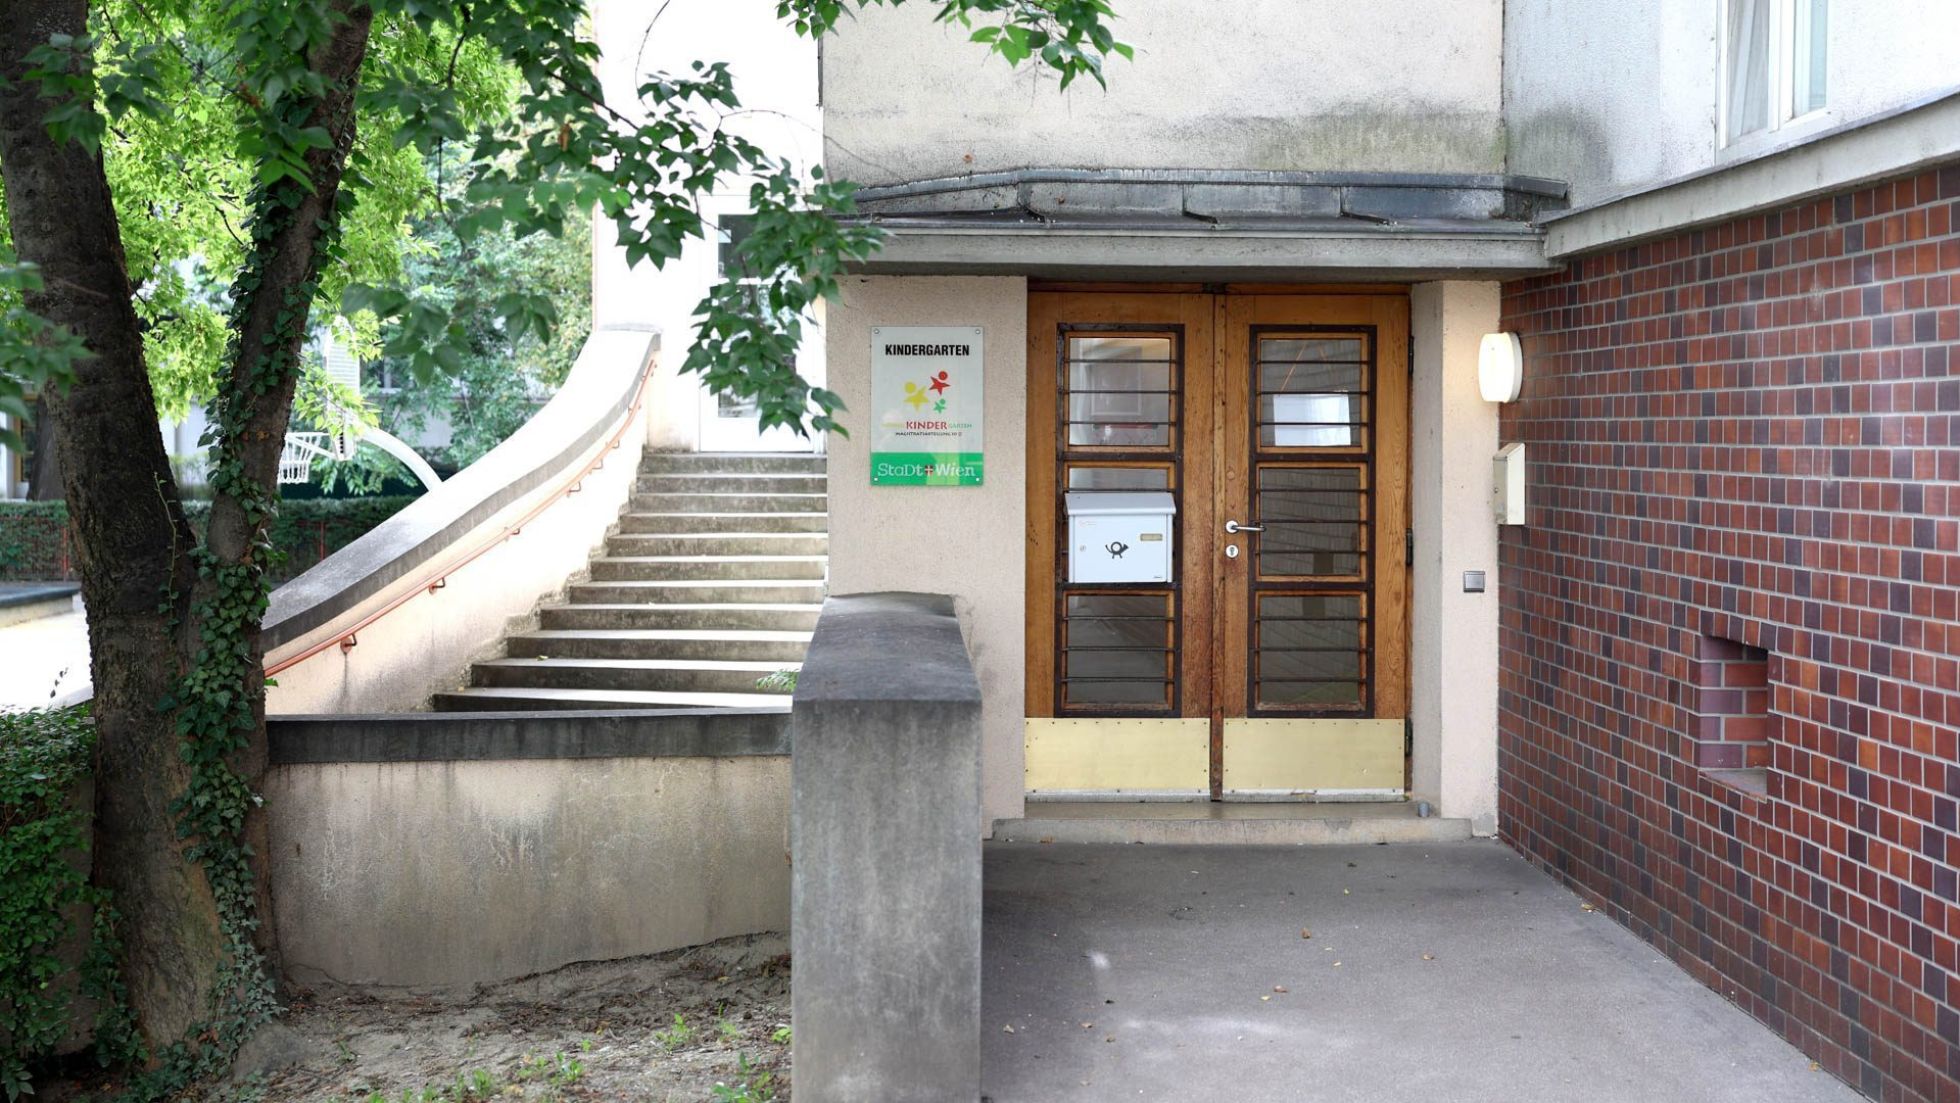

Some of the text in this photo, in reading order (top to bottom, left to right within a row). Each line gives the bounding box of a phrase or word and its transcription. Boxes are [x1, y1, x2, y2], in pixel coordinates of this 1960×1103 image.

[885, 344, 970, 356] KINDERGARTEN
[906, 421, 948, 430] KINDER
[935, 462, 976, 477] Wien
